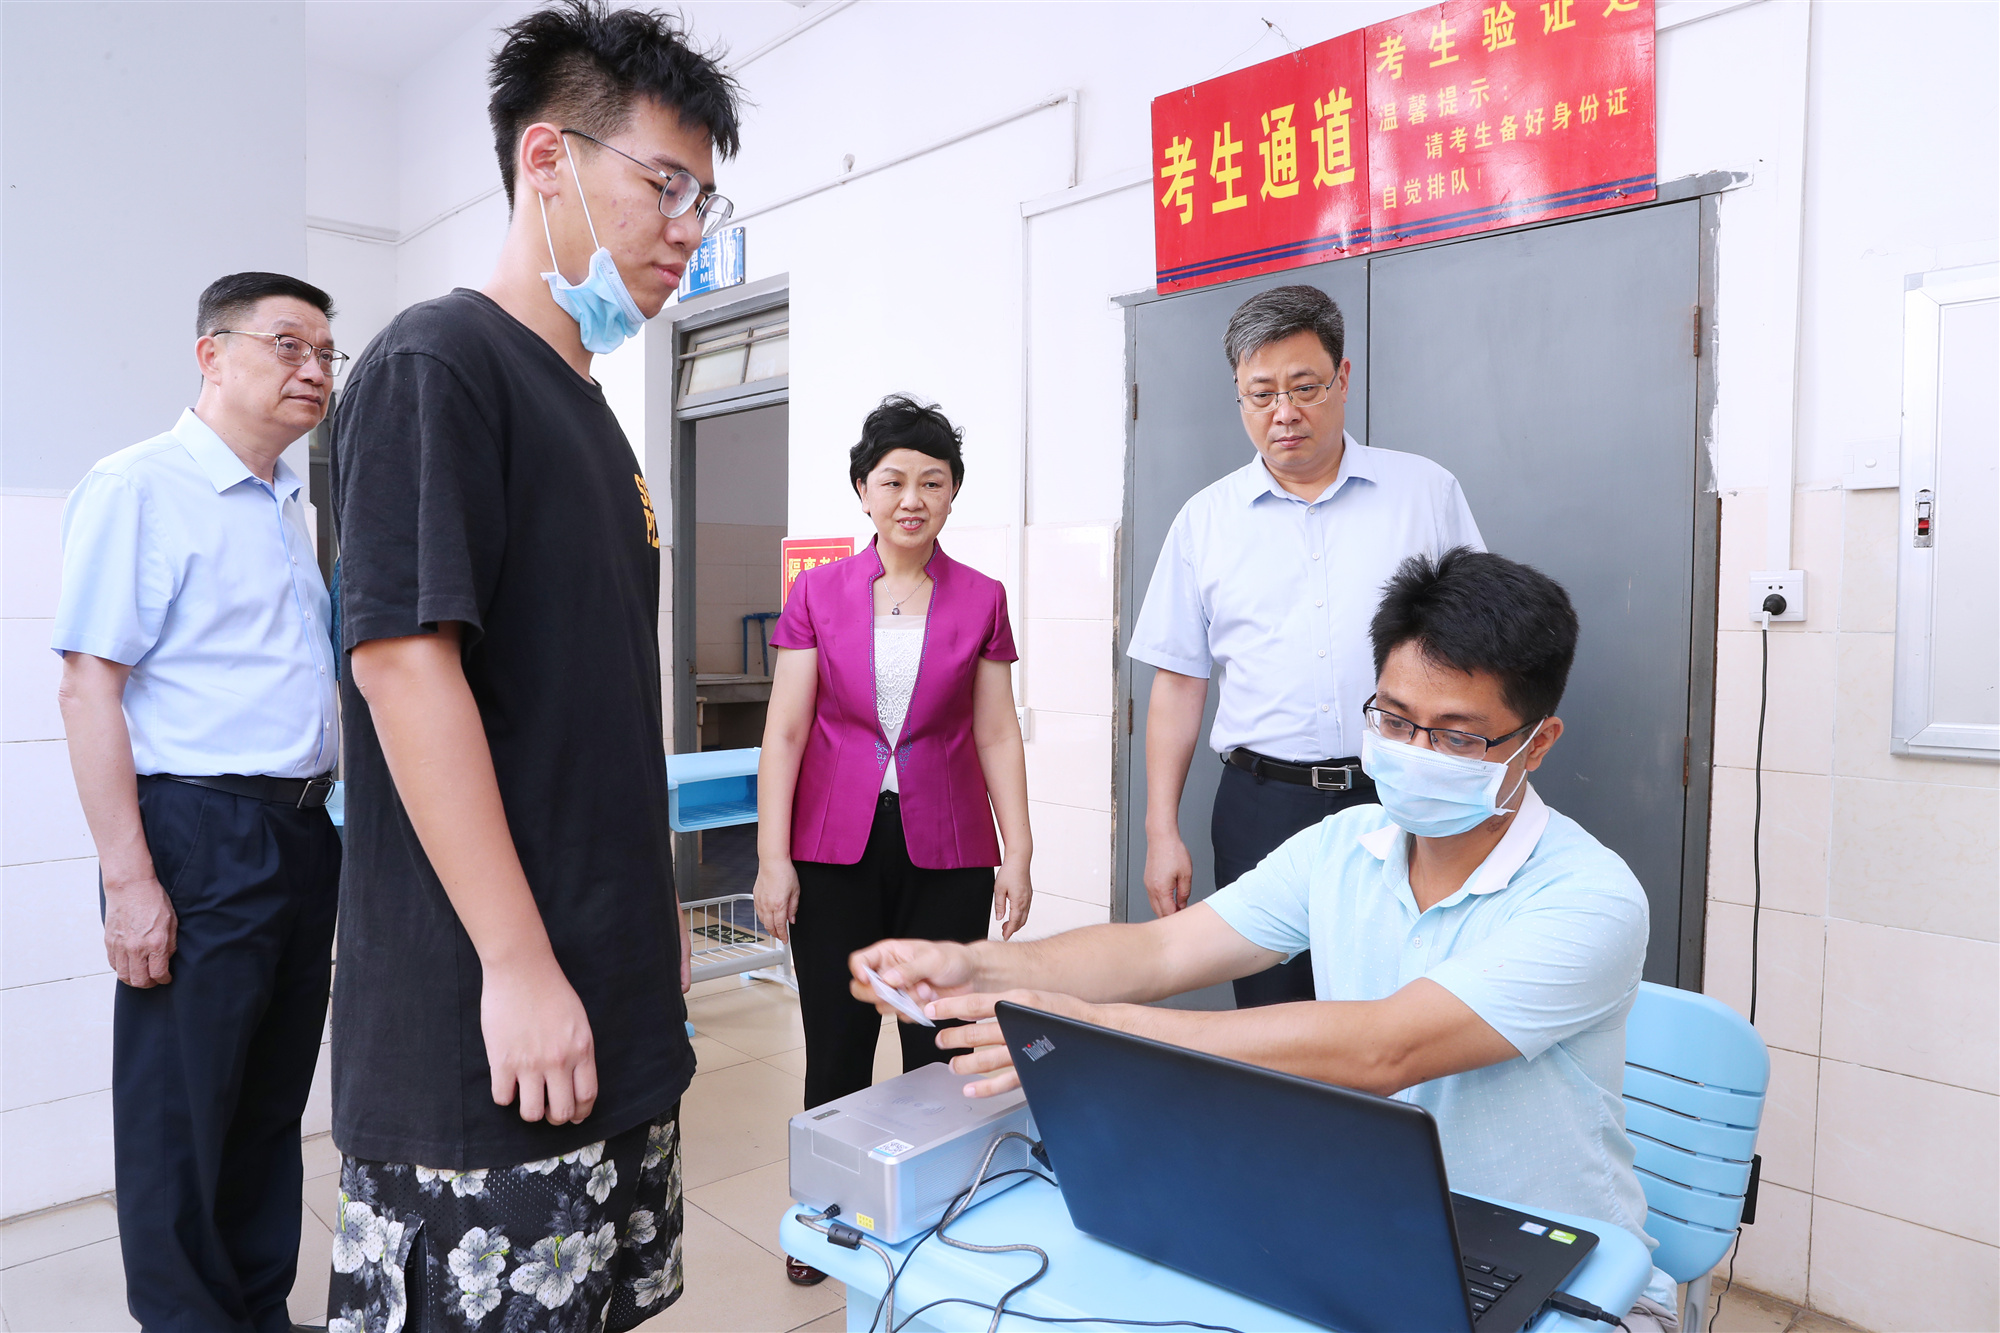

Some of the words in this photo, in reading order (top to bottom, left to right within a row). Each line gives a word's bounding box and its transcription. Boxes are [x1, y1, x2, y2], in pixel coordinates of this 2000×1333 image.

[1378, 77, 1509, 132] 温馨提示：
[1424, 86, 1629, 160] 请考生备好身份证
[1161, 86, 1356, 226] 考生通道
[1383, 167, 1482, 210] 自觉排队！
[788, 556, 844, 583] 隔离
